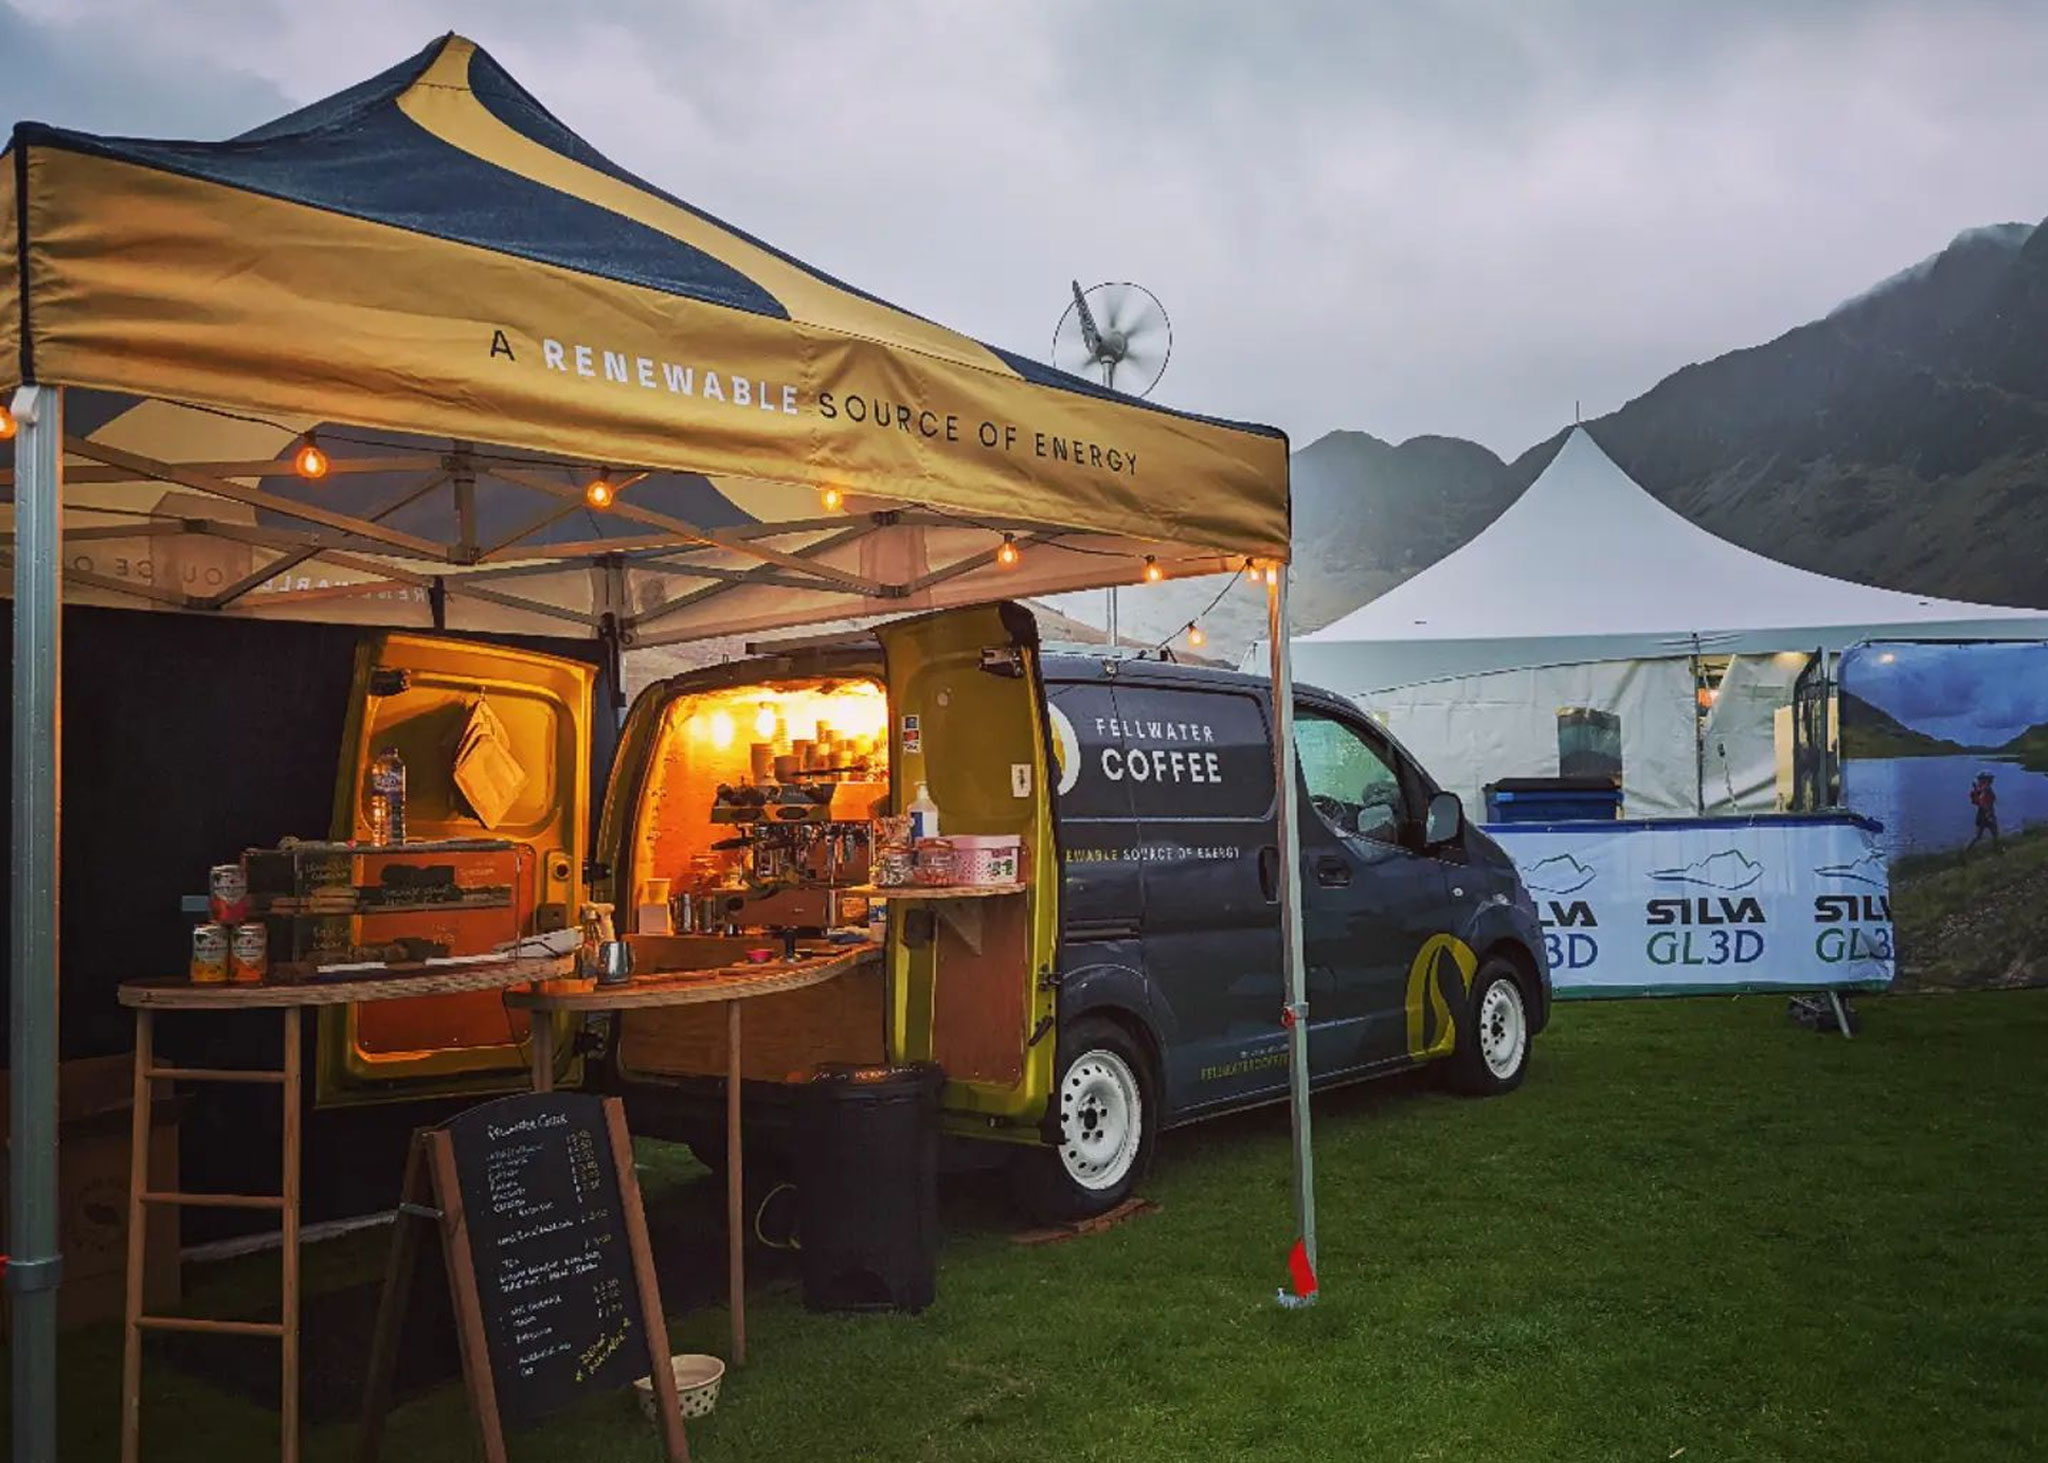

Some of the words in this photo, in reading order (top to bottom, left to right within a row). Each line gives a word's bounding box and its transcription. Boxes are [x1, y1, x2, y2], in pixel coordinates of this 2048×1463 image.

[490, 330, 515, 363] A
[542, 337, 799, 415] RENEWABLE
[818, 391, 960, 442] SOURCE
[979, 421, 1017, 450] OF
[1033, 433, 1139, 476] ENERGY
[1095, 718, 1215, 742] FELLWATER
[1101, 748, 1222, 783] COFFEE
[1123, 847, 1172, 861] SOURCE
[1197, 846, 1240, 860] ENERGY
[1646, 897, 1766, 925] SILVA
[1646, 929, 1765, 965] GL3D
